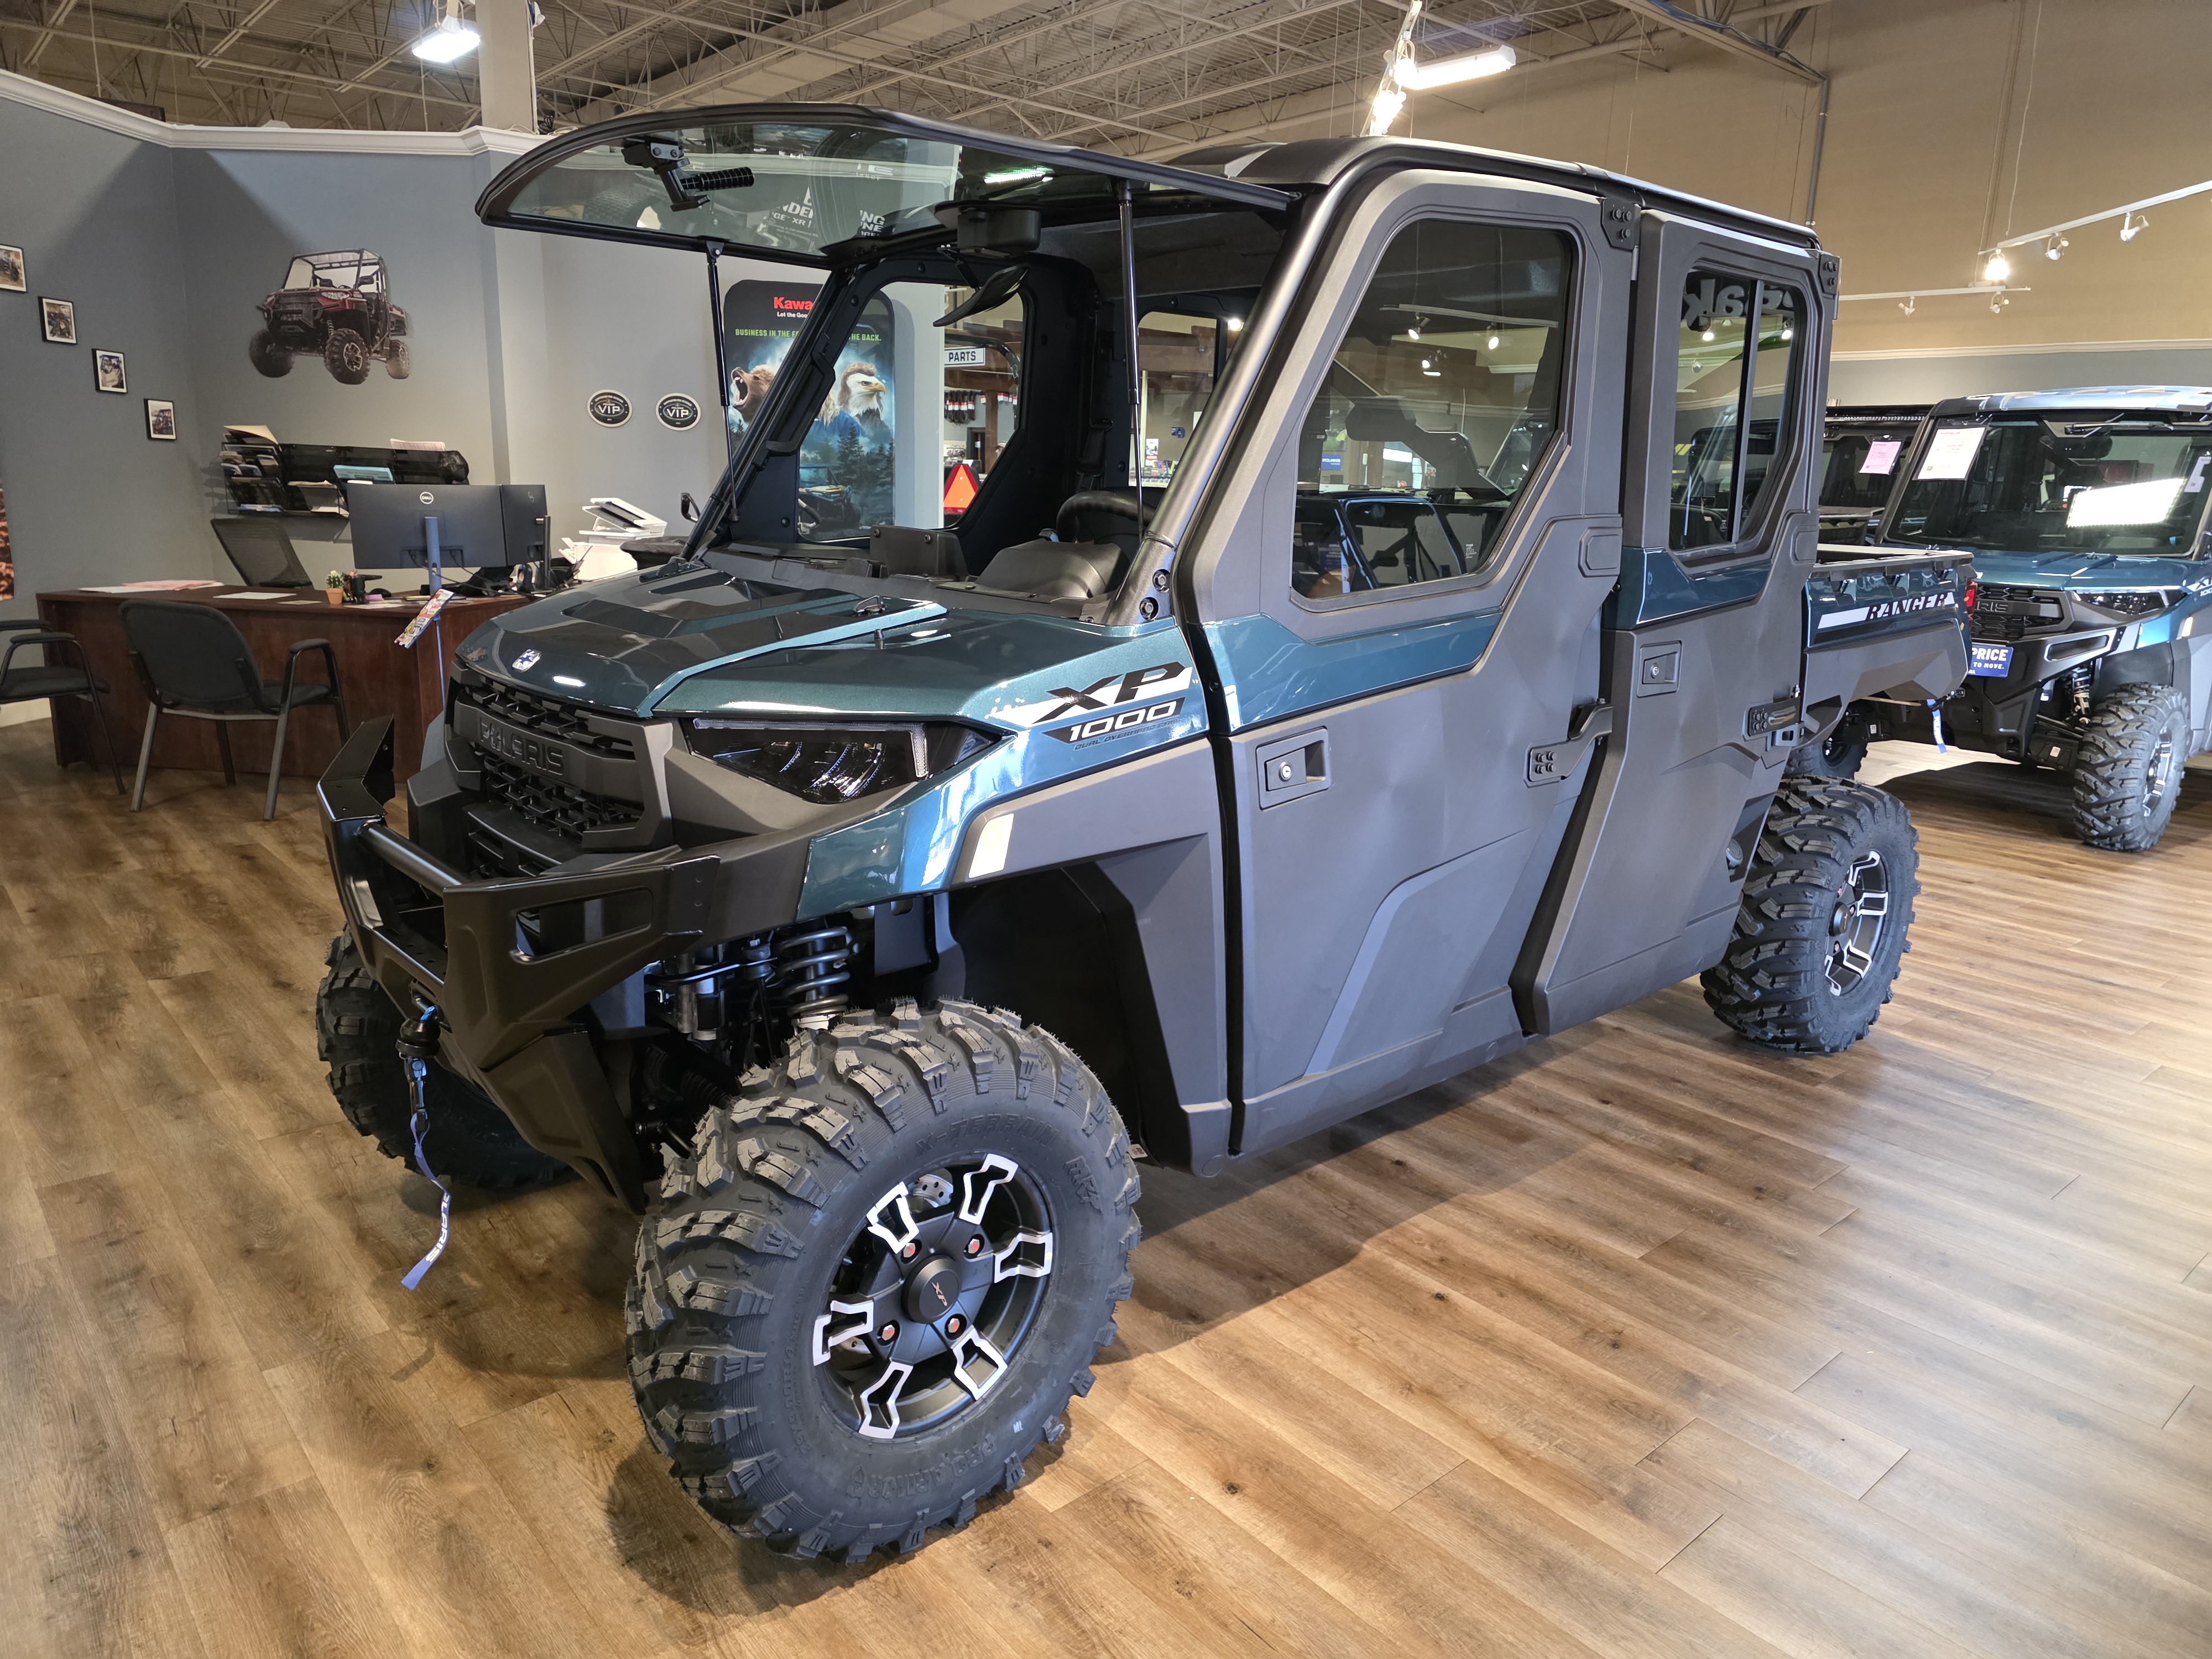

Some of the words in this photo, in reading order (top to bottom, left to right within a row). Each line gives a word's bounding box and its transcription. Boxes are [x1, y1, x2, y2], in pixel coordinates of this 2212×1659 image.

[774, 296, 813, 310] Kawa
[948, 351, 976, 362] PARTS
[598, 405, 620, 414] VIP
[667, 409, 689, 417] VIP
[1865, 592, 1948, 620] RANGER
[1031, 661, 1186, 724] XP
[1069, 700, 1177, 742] 1000
[479, 717, 565, 775] POLARIS
[1074, 740, 1100, 750] DUAL
[1104, 725, 1156, 742] OVERHEAD
[931, 1282, 947, 1306] XP
